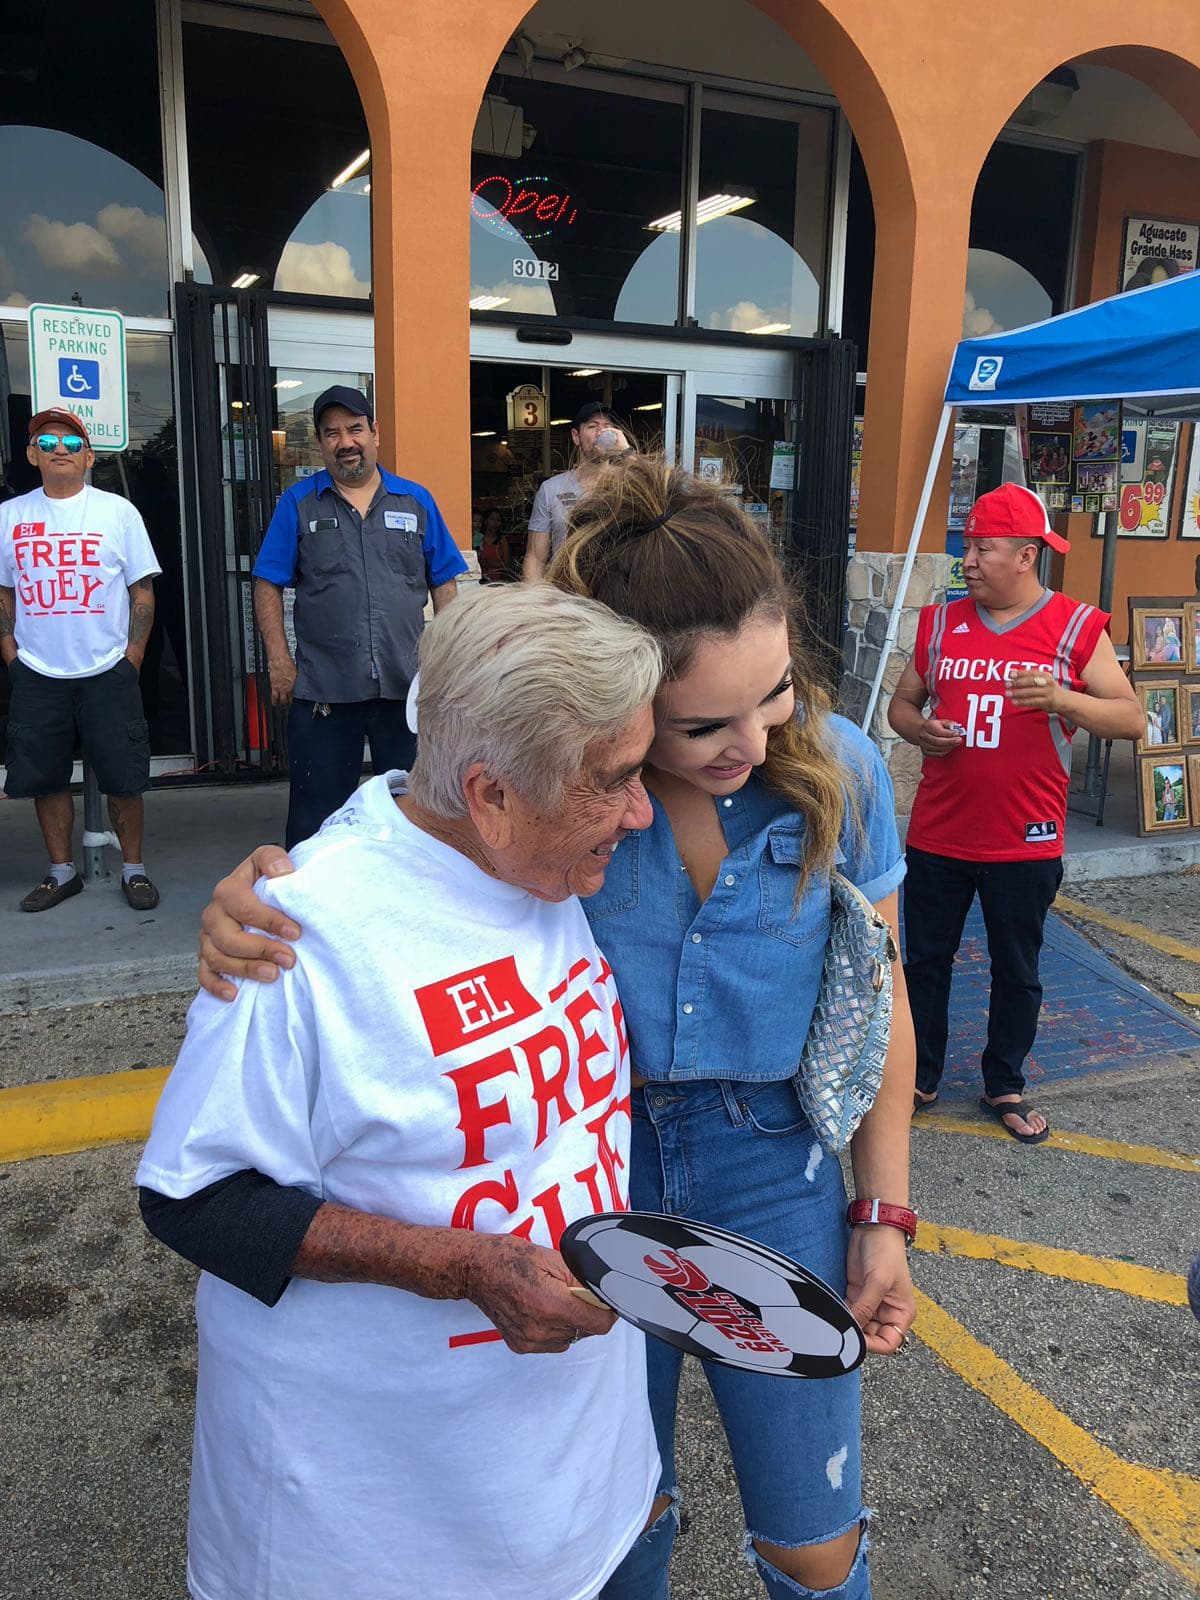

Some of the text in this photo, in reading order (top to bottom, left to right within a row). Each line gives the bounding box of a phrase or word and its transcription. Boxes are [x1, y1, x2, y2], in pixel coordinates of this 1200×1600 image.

[1139, 223, 1187, 243] Aguacate
[1130, 240, 1193, 260] Grande Hass
[514, 259, 557, 279] 3012
[43, 319, 111, 338] RESERVED
[49, 337, 107, 356] PARKING
[68, 404, 93, 417] VAN
[524, 402, 538, 427] 3
[86, 423, 120, 437] SIBLE
[21, 525, 37, 536] EL
[15, 539, 101, 571] FREE
[18, 569, 104, 609] GUEY
[966, 693, 1004, 748] 13
[446, 975, 514, 1034] EL
[743, 1317, 792, 1353] BUENA
